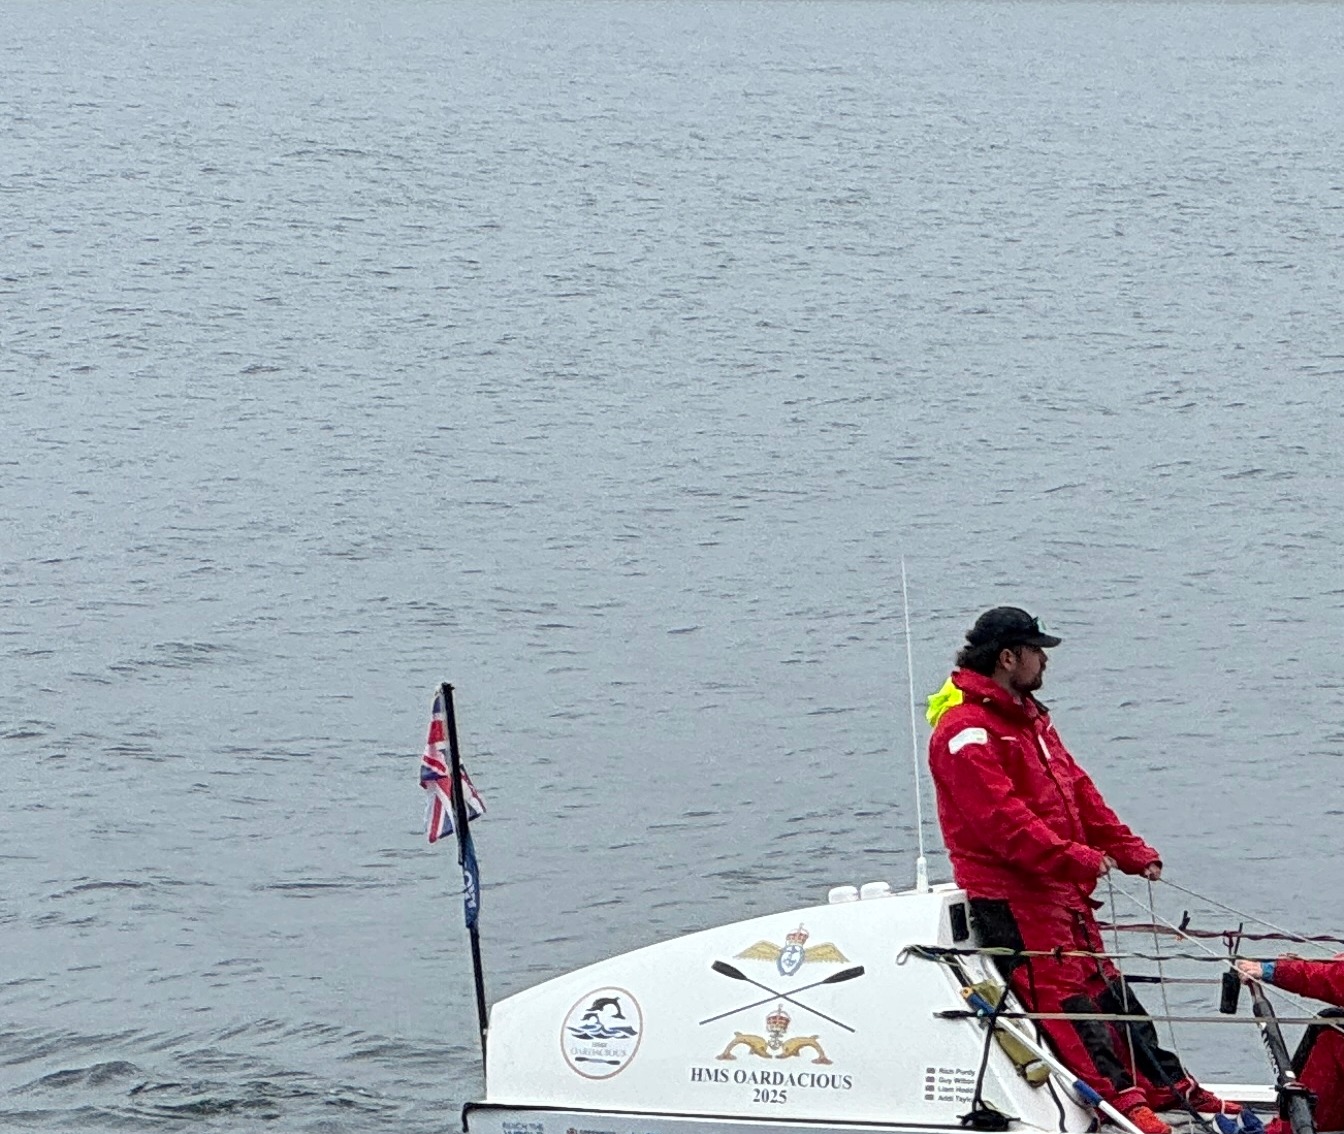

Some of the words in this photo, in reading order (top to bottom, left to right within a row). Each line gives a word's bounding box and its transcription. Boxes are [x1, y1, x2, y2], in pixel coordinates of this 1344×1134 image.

[691, 1067, 729, 1083] HMS
[733, 1069, 852, 1090] OARDACIOUS
[753, 1088, 787, 1104] 2025
